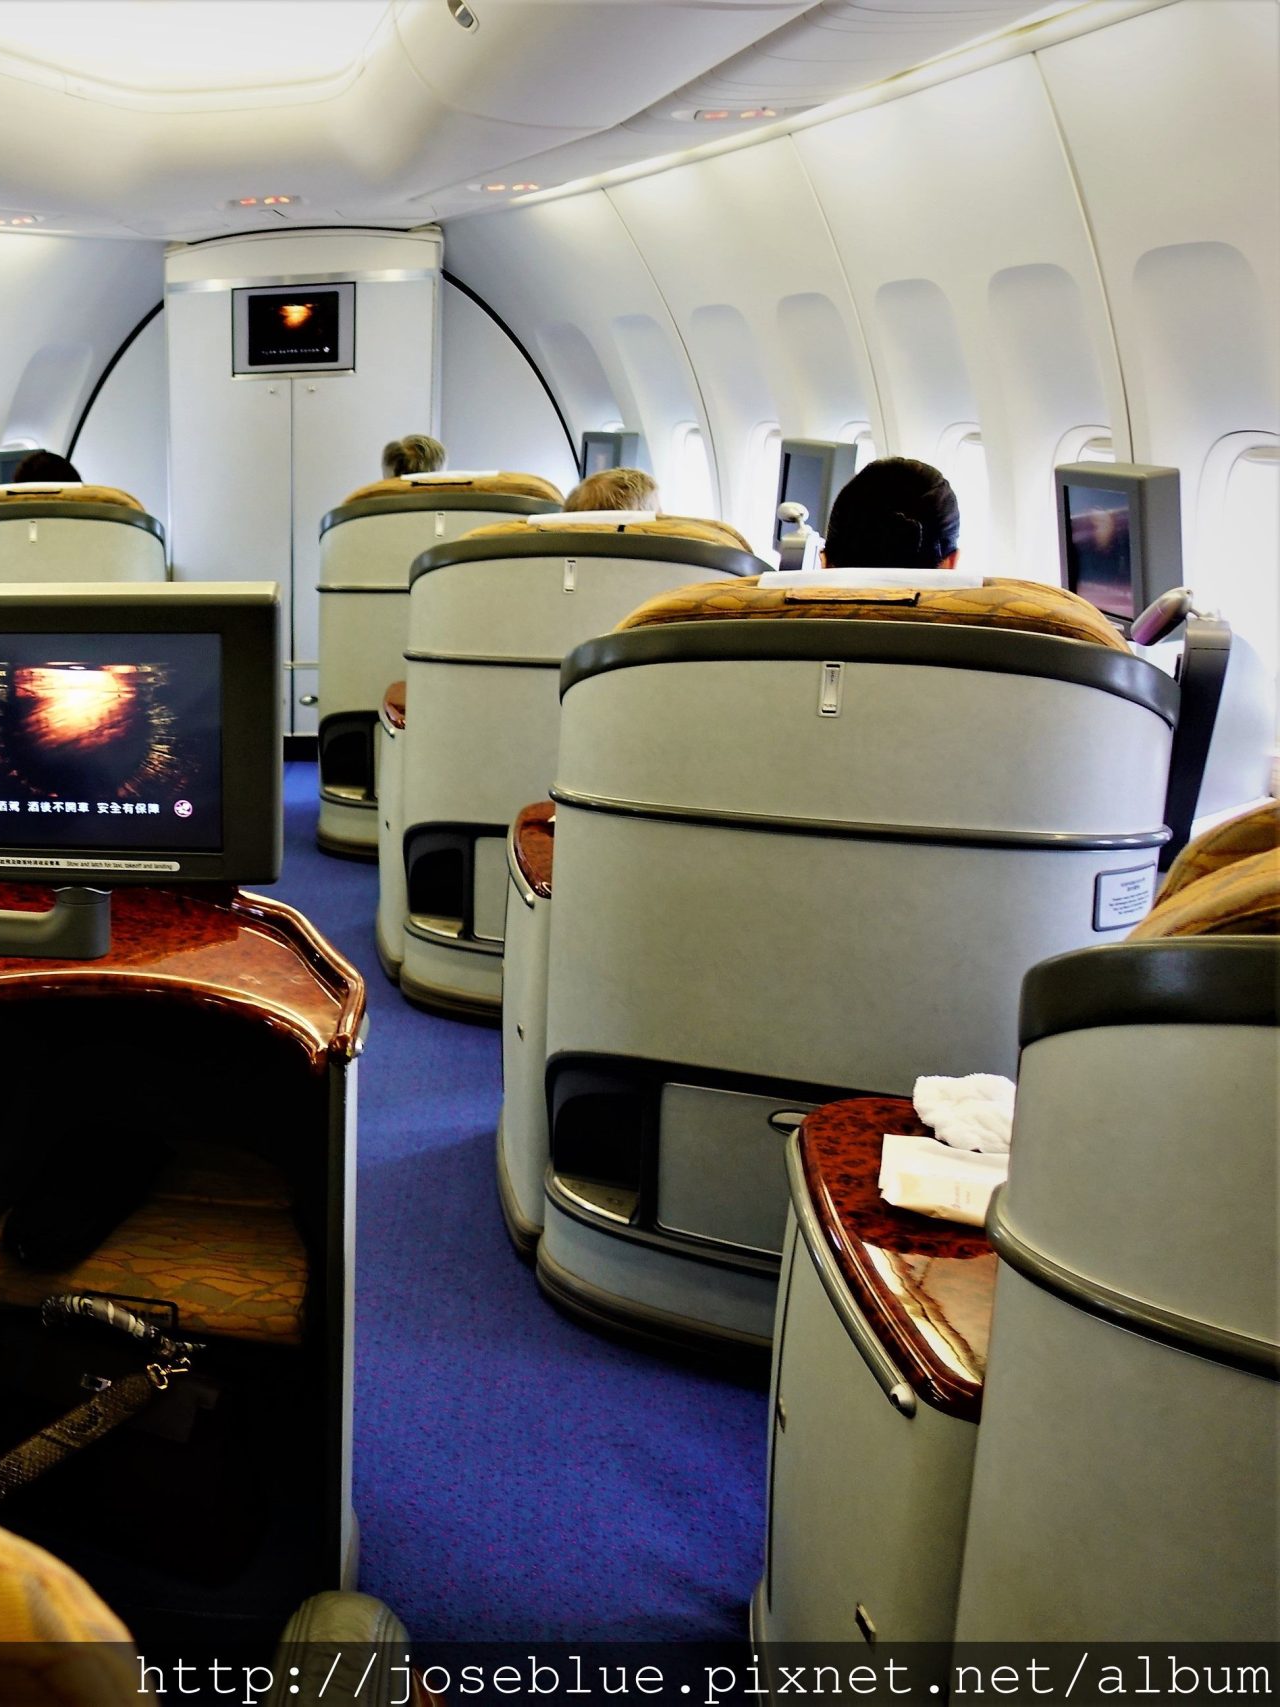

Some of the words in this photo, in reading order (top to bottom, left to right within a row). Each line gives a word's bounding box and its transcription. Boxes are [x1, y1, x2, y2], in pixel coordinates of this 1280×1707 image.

[27, 801, 90, 813] 酒後不開車
[97, 802, 160, 814] 安全有保障
